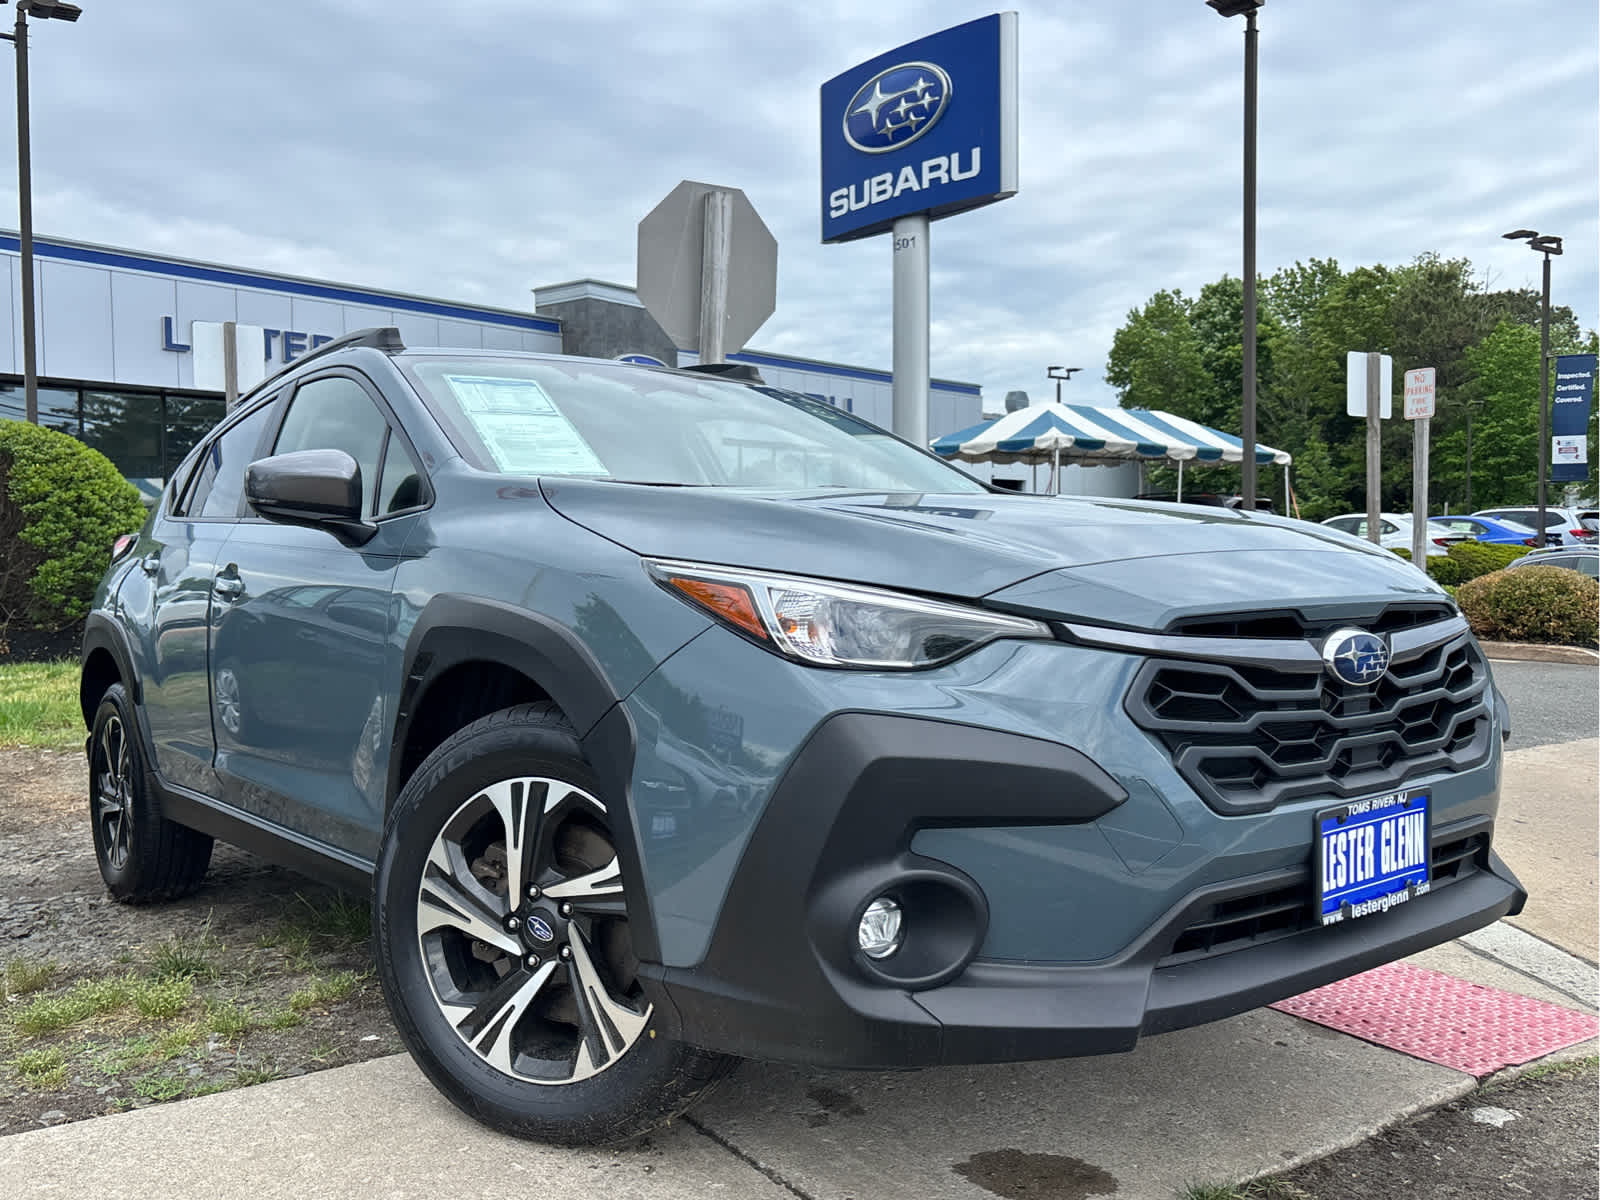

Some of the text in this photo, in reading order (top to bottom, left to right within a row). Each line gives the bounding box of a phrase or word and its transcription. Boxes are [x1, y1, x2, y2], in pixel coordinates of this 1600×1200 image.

[830, 147, 981, 219] SUBARU
[1414, 375, 1425, 384] NO
[1347, 801, 1370, 816] TOMS
[1397, 791, 1408, 805] NJ
[1322, 812, 1425, 893] LESTER GLENN
[1351, 890, 1409, 918] lesterglenn
